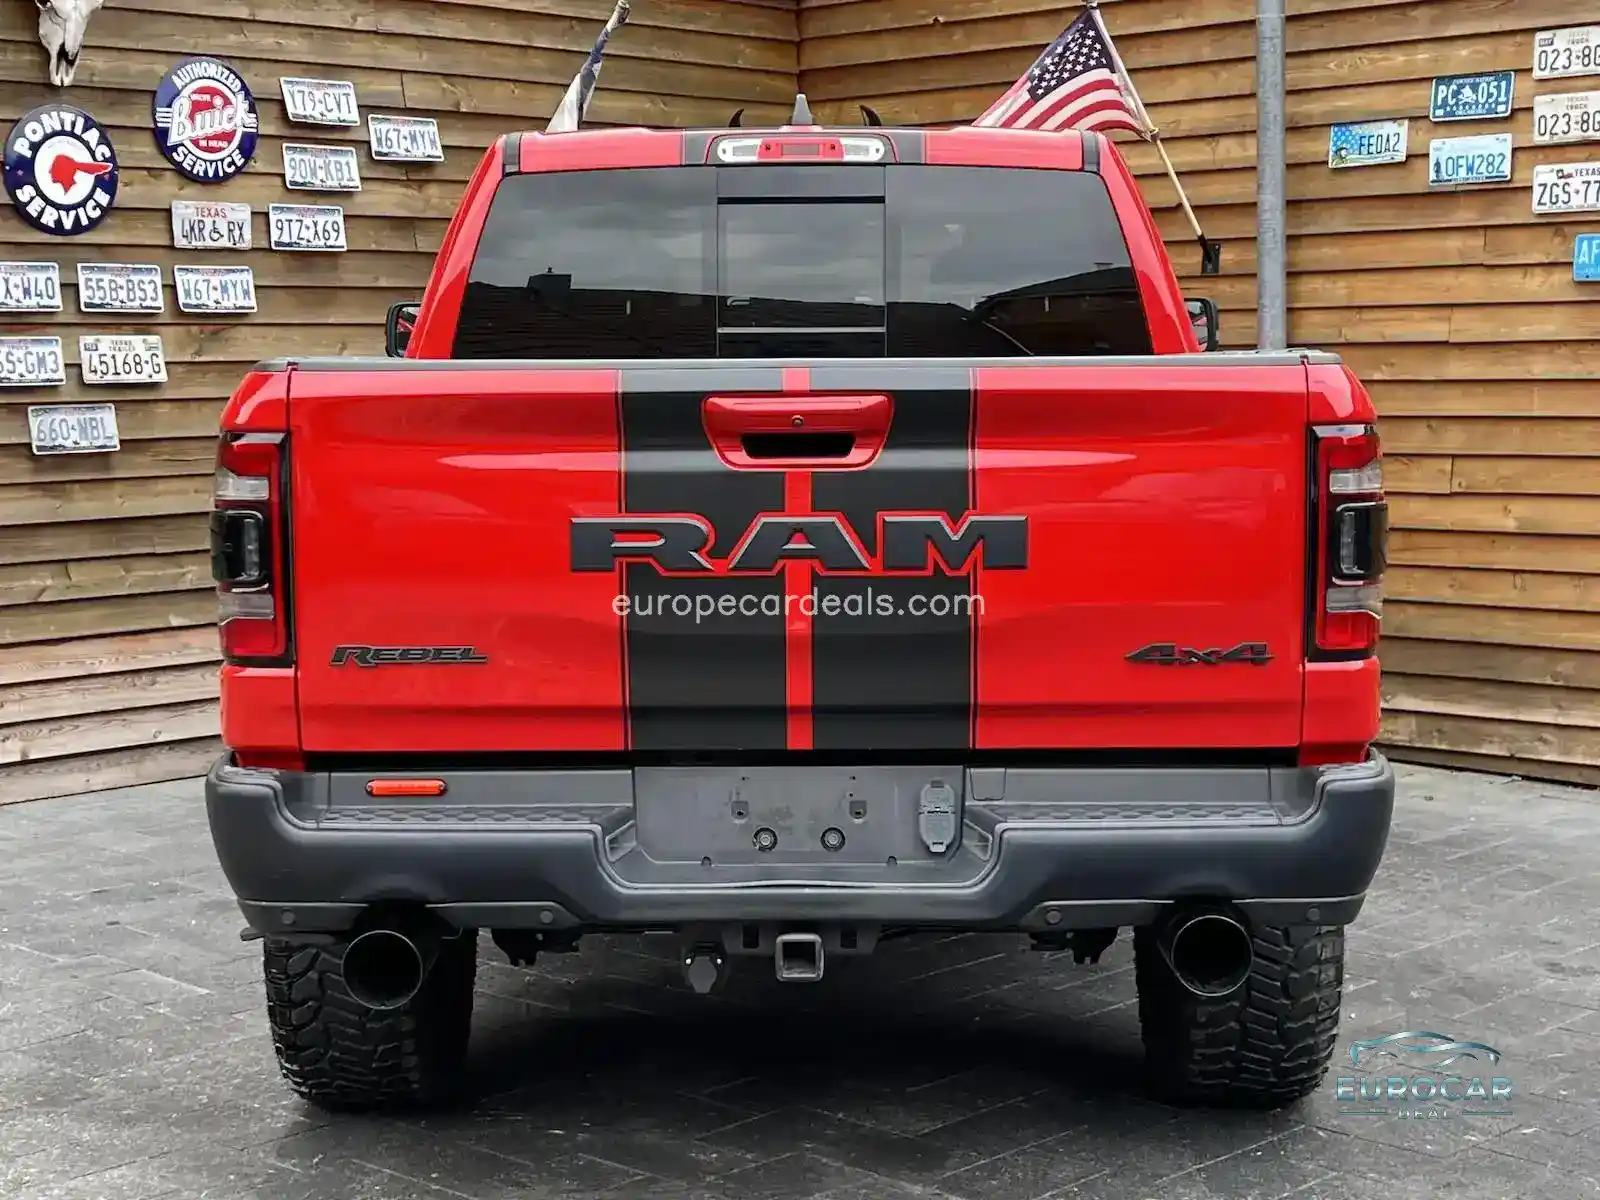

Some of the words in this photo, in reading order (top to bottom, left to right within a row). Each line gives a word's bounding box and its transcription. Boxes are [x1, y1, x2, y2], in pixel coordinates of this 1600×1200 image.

[171, 62, 241, 92] AUTHORIZED
[13, 110, 112, 162] PONTIAC
[167, 91, 252, 146] Buick
[172, 145, 245, 177] SERVICE
[16, 184, 112, 230] SERVICE
[195, 207, 228, 218] TEXAS
[570, 513, 1029, 575] RAM
[329, 644, 488, 667] REBEL
